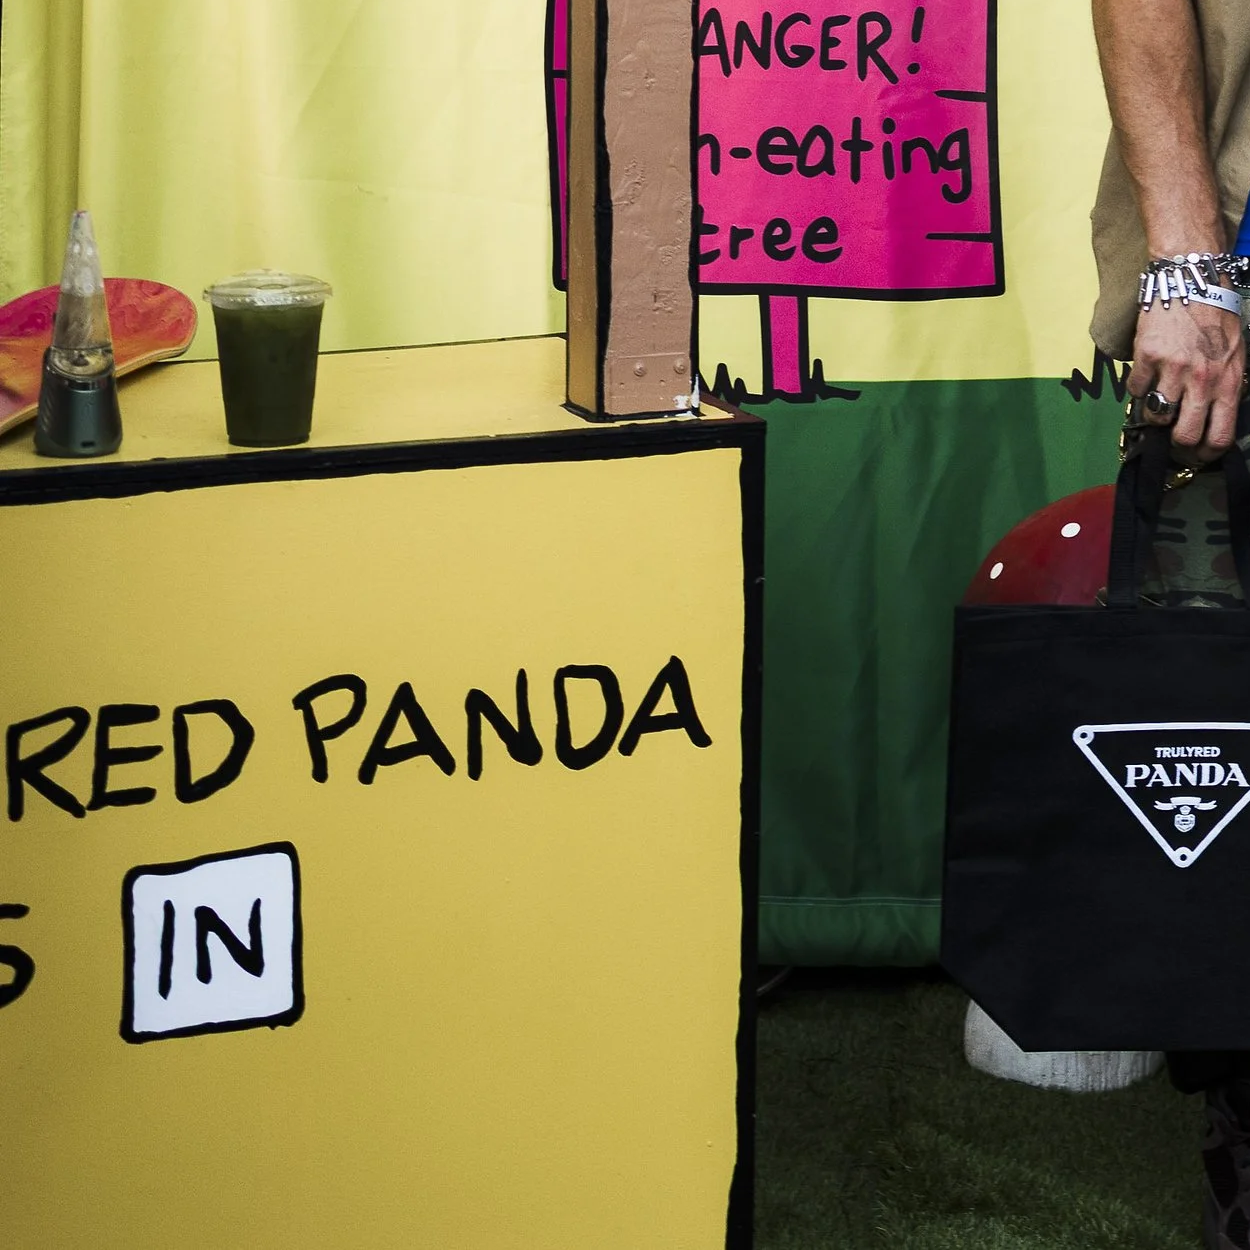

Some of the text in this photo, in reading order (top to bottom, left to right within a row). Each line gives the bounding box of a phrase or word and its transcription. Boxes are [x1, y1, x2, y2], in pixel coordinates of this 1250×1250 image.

[698, 7, 925, 84] ANGER!
[698, 116, 971, 203] n-eating
[6, 655, 713, 822] RED PANDA
[1124, 762, 1250, 788] PANDA
[1154, 746, 1221, 759] TRULYRED
[158, 897, 266, 1001] IN
